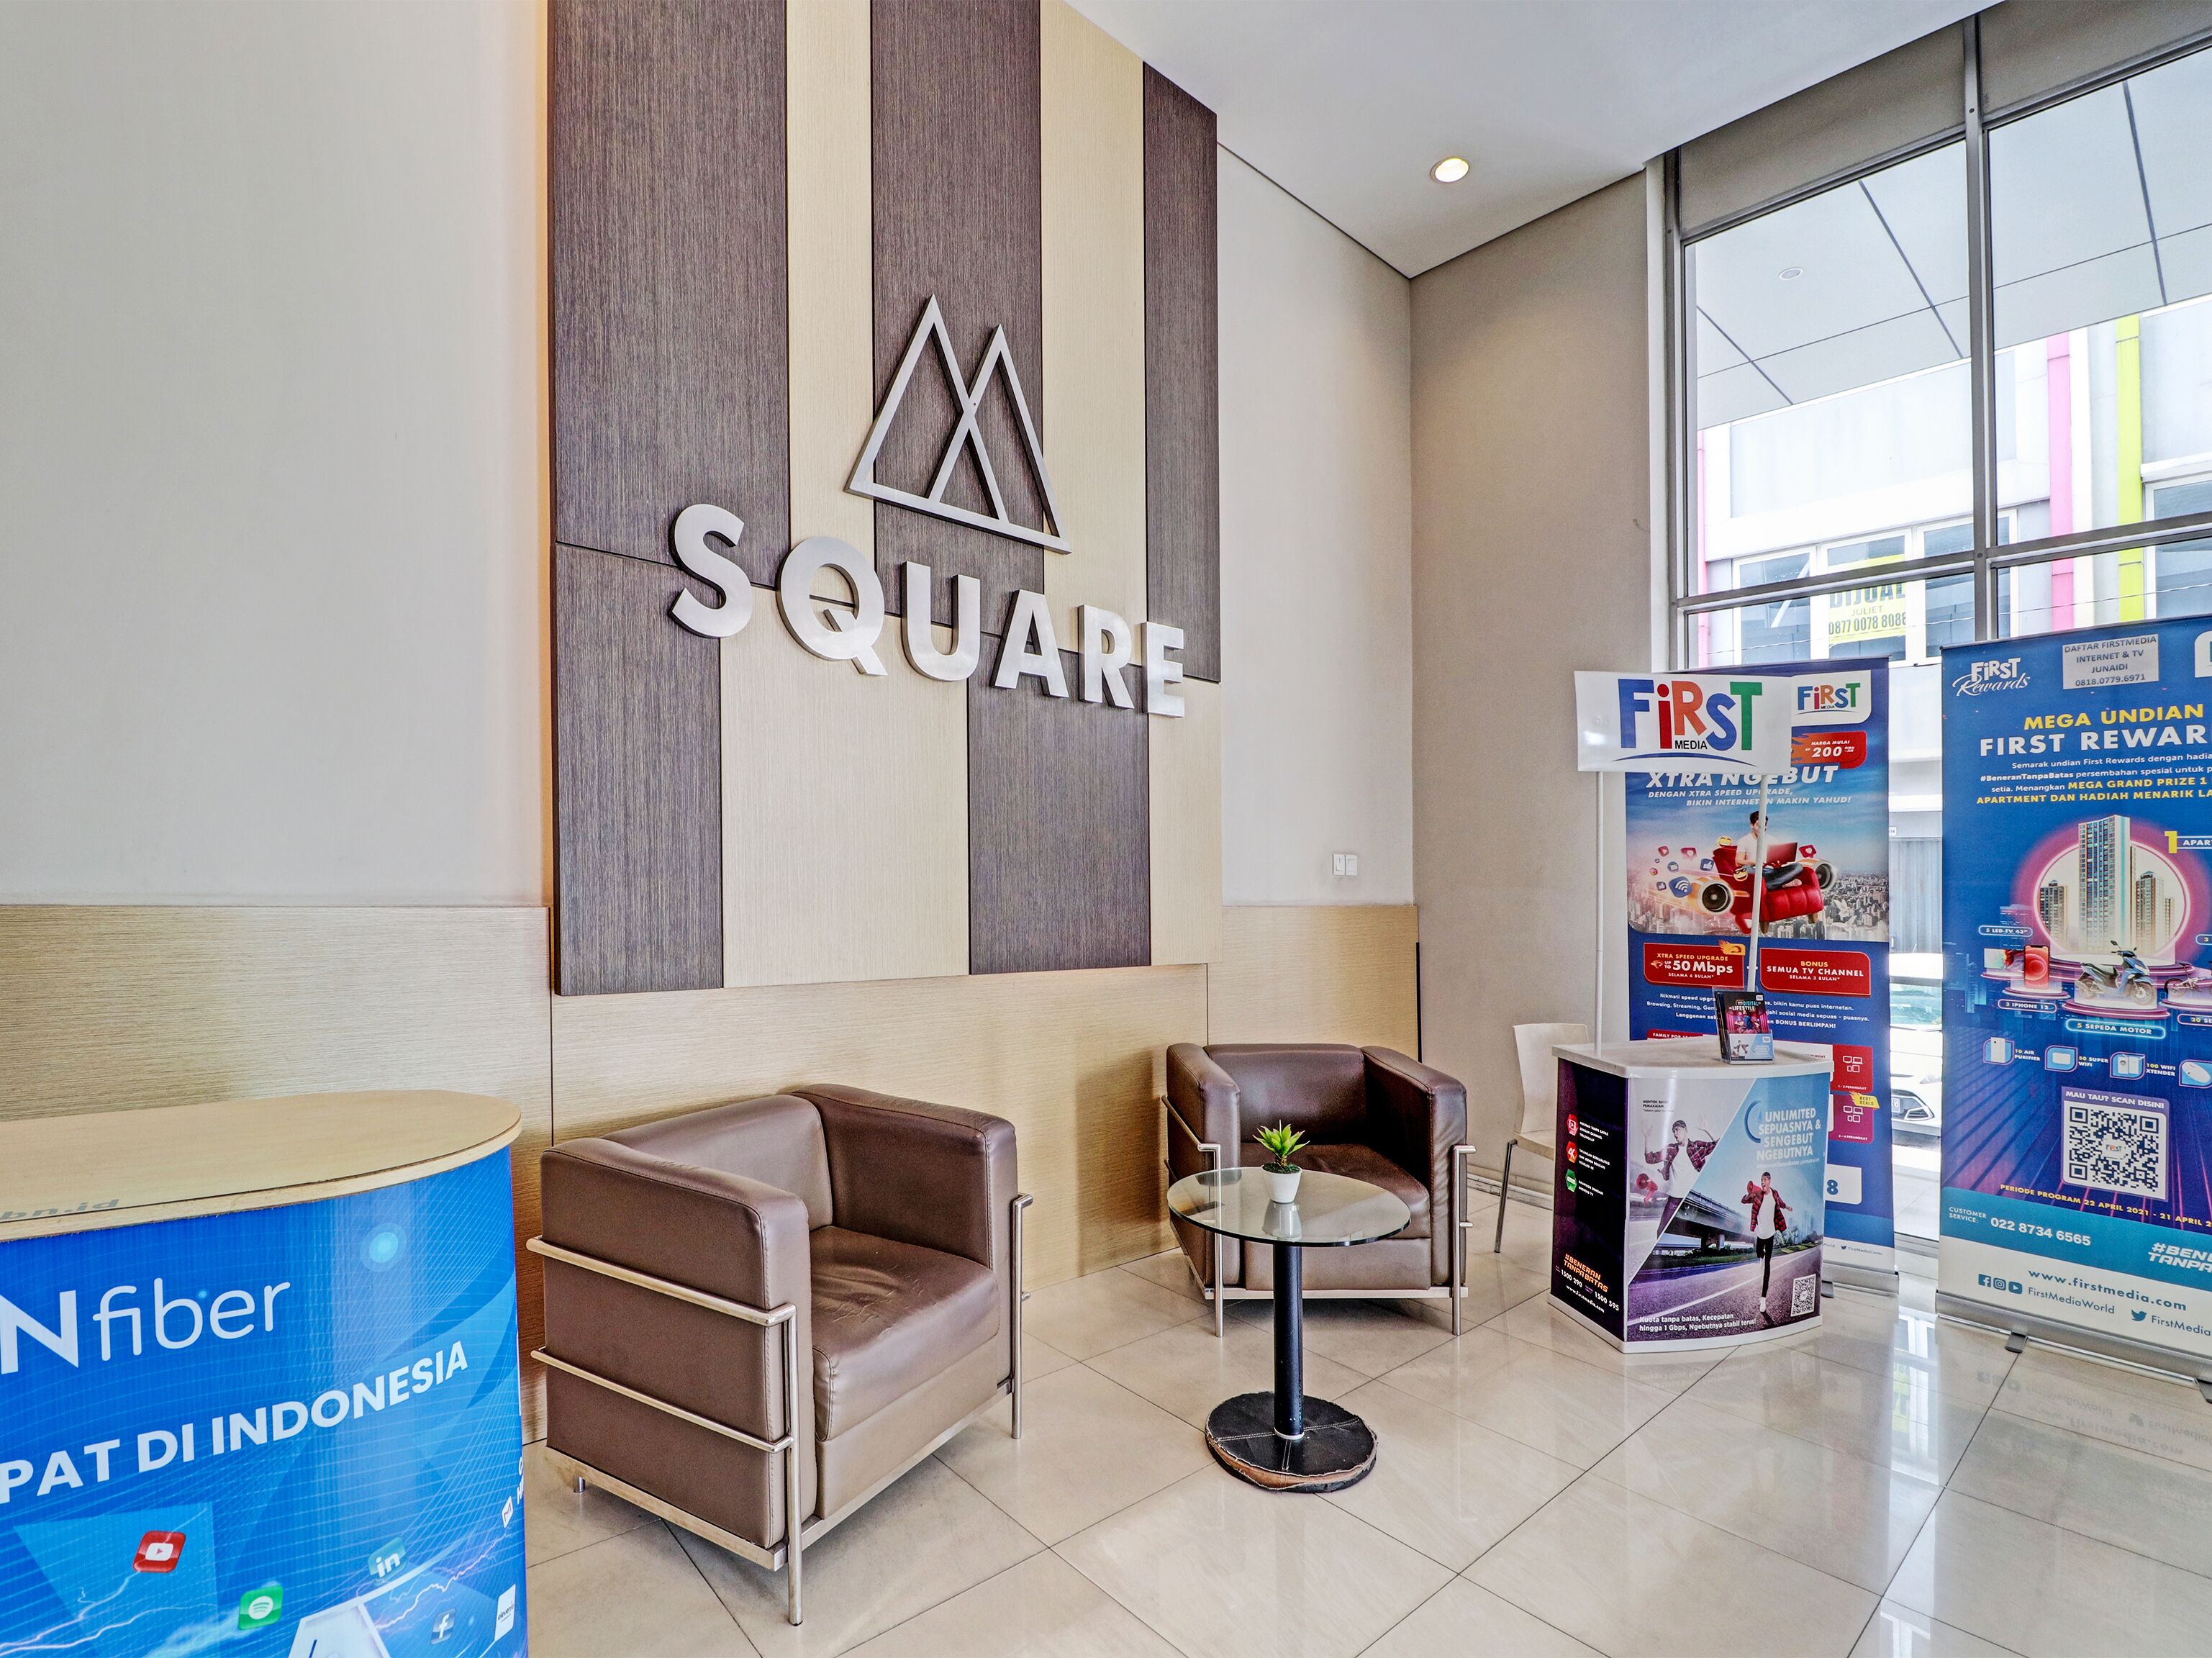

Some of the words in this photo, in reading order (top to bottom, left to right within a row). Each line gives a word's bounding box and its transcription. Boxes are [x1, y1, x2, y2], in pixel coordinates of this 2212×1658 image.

[668, 503, 1185, 718] SQUARE
[1851, 605, 1883, 617] JULIET
[1828, 620, 1851, 635] 0877
[1854, 616, 1878, 632] 0078
[2064, 643, 2099, 653] DAFTAR
[2102, 636, 2157, 649] FIRSTMEDIA
[2076, 651, 2120, 663] INTERNET
[2092, 663, 2128, 673] JUNAIDI
[1952, 672, 2031, 697] Rewards
[2075, 674, 2146, 687] 0818.0779.6971
[2023, 712, 2092, 730] MEGA
[2100, 704, 2203, 725] UNDIAN
[1674, 740, 1708, 750] MEDIA
[1980, 733, 2065, 756] FIRST
[2080, 724, 2212, 751] REWAR
[1811, 746, 1842, 758] 200
[2148, 754, 2183, 763] dengan
[1646, 772, 1713, 788] XTRA
[1980, 772, 2074, 782] #BeneranTanpaBatas
[2076, 769, 2138, 779] persembahan
[2140, 767, 2172, 776] spesial
[2016, 784, 2065, 792] Menangkan
[2068, 781, 2103, 789] MEGA
[2107, 779, 2153, 788] GRAND
[2157, 777, 2195, 786] PRIZE
[1745, 788, 1793, 797] UPRADE,
[1977, 794, 2046, 804] APARTMENT
[2080, 792, 2129, 801] HADIAH
[2133, 790, 2193, 799] MENARIK
[2165, 830, 2177, 853] 1
[1672, 960, 1691, 971] 50
[1692, 961, 1733, 975] Mbps
[1818, 968, 1864, 977] CHANNEL
[2088, 1093, 2109, 1102] TAU?
[2111, 1096, 2136, 1105] SCAN
[2138, 1100, 2165, 1109] DISINI
[1765, 1108, 1816, 1123] UNLIMITED
[1758, 1120, 1813, 1135] SEPUASNYA
[1815, 1119, 1822, 1130] &
[1764, 1133, 1813, 1148] SENGEBUT
[1756, 1146, 1813, 1161] NGEBUTNYA
[2000, 1184, 2035, 1195] PERIODE
[2037, 1191, 2081, 1203] PROGRAM
[2098, 1202, 2123, 1211] APRIL
[2126, 1206, 2149, 1215] 2021
[2175, 1215, 2202, 1226] APRIL
[1949, 1207, 1986, 1219] CUSTOMER
[1949, 1213, 1979, 1223] SERVICE:
[1990, 1217, 2016, 1231] 022
[2018, 1223, 2053, 1238] 8734
[2056, 1230, 2091, 1246] 6565
[1564, 1253, 1601, 1281] #BENERAN
[1573, 1277, 1583, 1288] 290
[2029, 1269, 2187, 1311] www.firstmedia.com
[2028, 1287, 2116, 1314] FirstMediaWorld
[1689, 1322, 1722, 1331] Ngebutnya
[2151, 1315, 2211, 1336] FirstMedia
[0, 1440, 120, 1504] PAT
[137, 1423, 195, 1473] DI
[212, 1341, 468, 1456] INDONESIA
